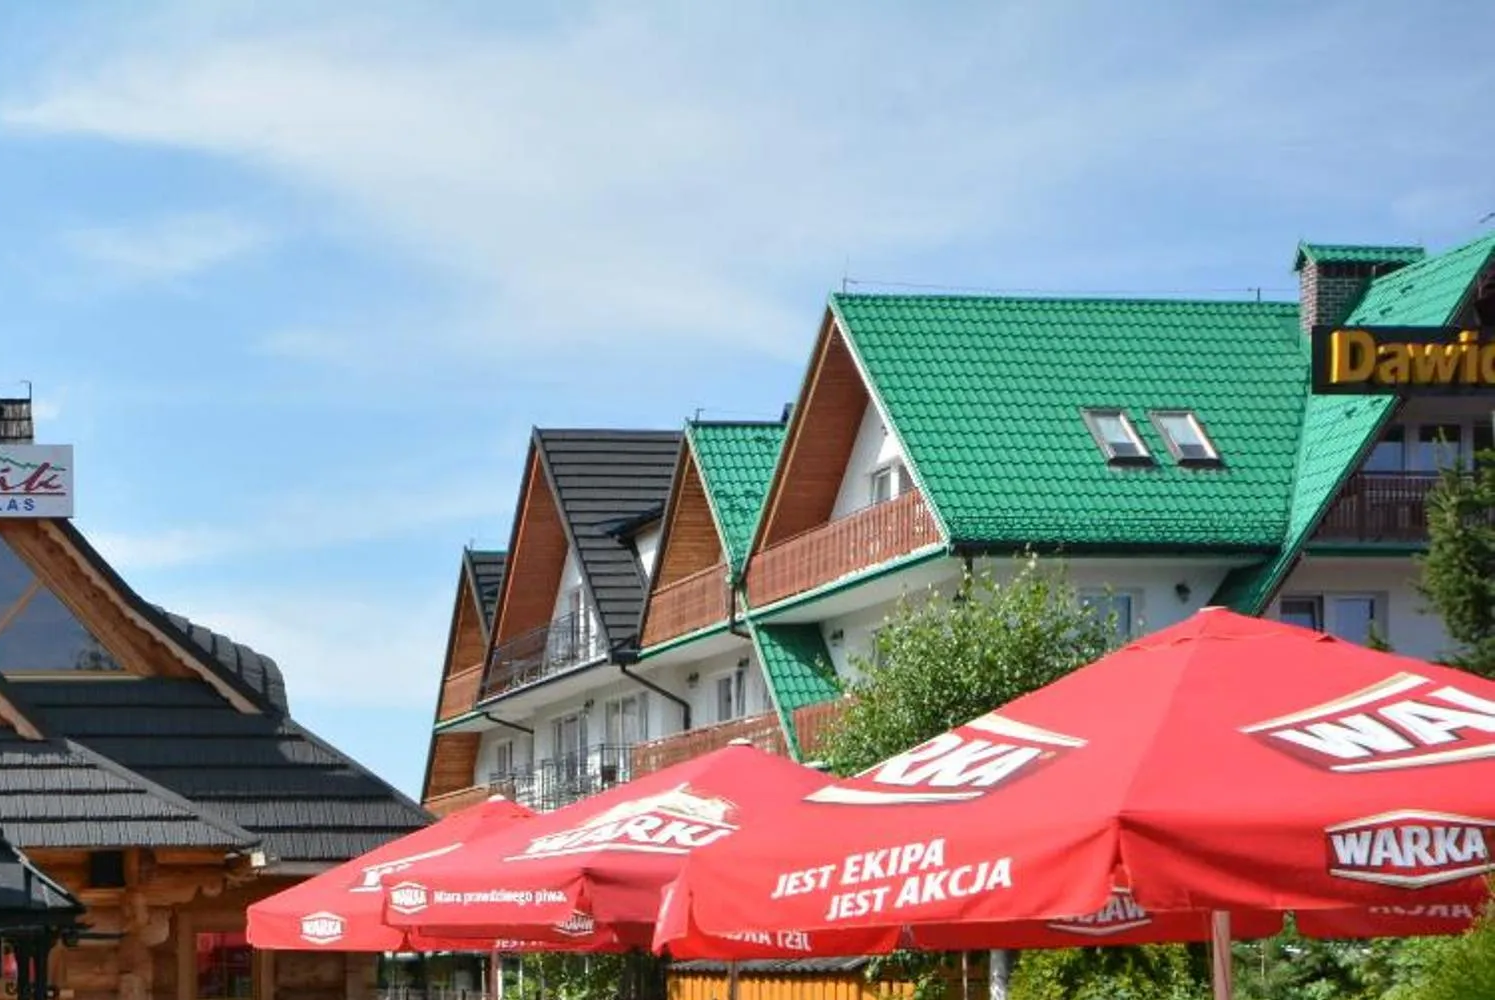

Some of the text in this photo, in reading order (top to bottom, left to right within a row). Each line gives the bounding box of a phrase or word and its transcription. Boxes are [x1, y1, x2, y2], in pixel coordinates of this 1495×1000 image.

[873, 731, 1043, 787] RKA
[770, 838, 946, 900] JEST EKIPA
[1331, 825, 1488, 868] WARKA
[825, 887, 891, 922] JEST
[894, 857, 1013, 909] AKCJA
